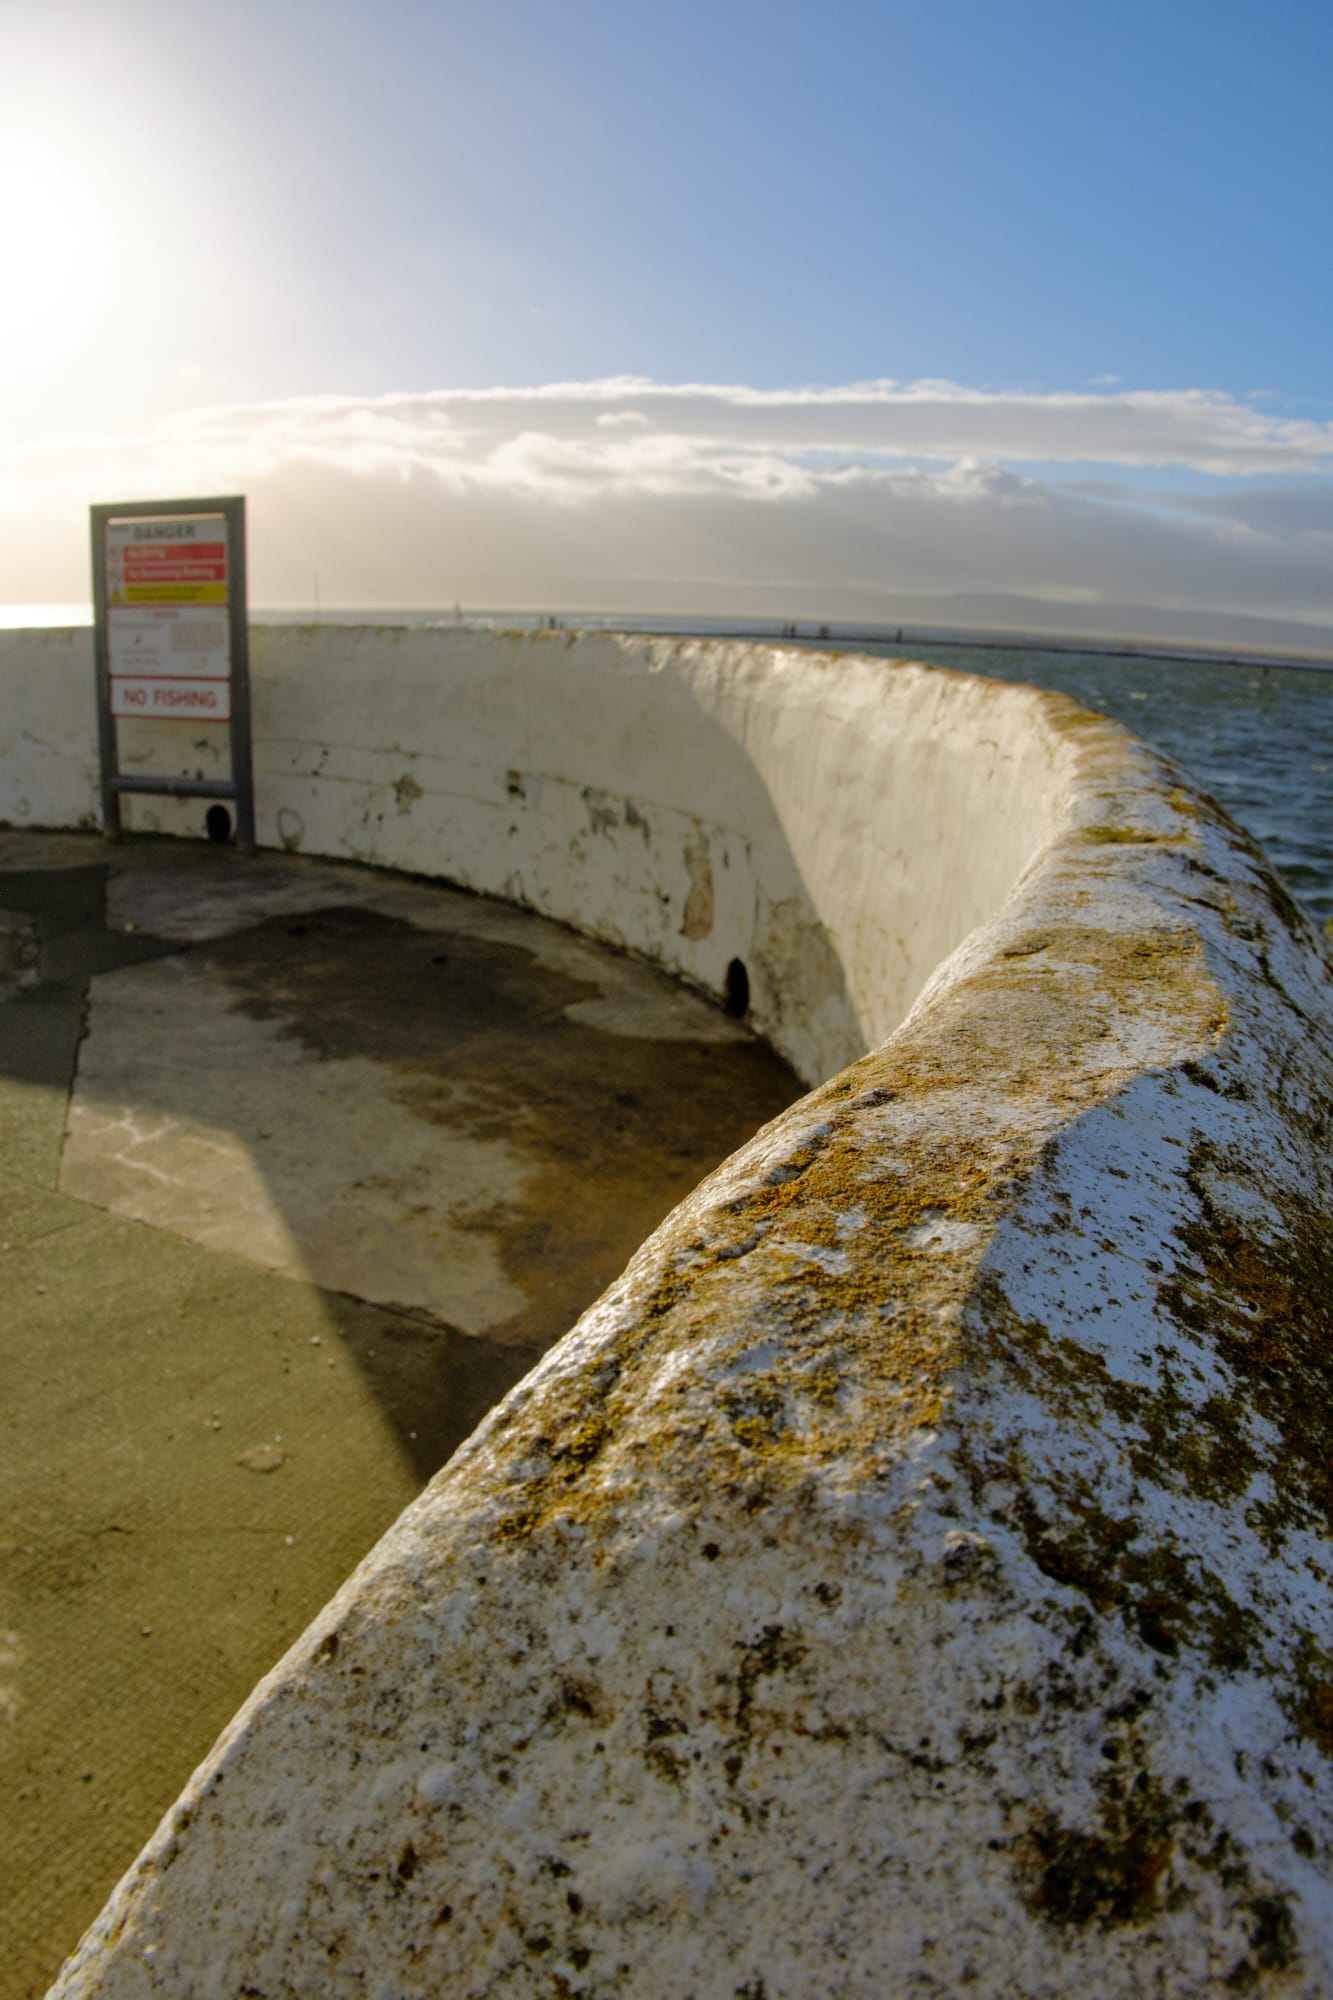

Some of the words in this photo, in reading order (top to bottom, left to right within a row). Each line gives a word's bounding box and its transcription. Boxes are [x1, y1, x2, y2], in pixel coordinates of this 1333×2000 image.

[133, 524, 196, 540] DANGER
[123, 688, 147, 706] NO
[153, 688, 217, 709] FISHING
